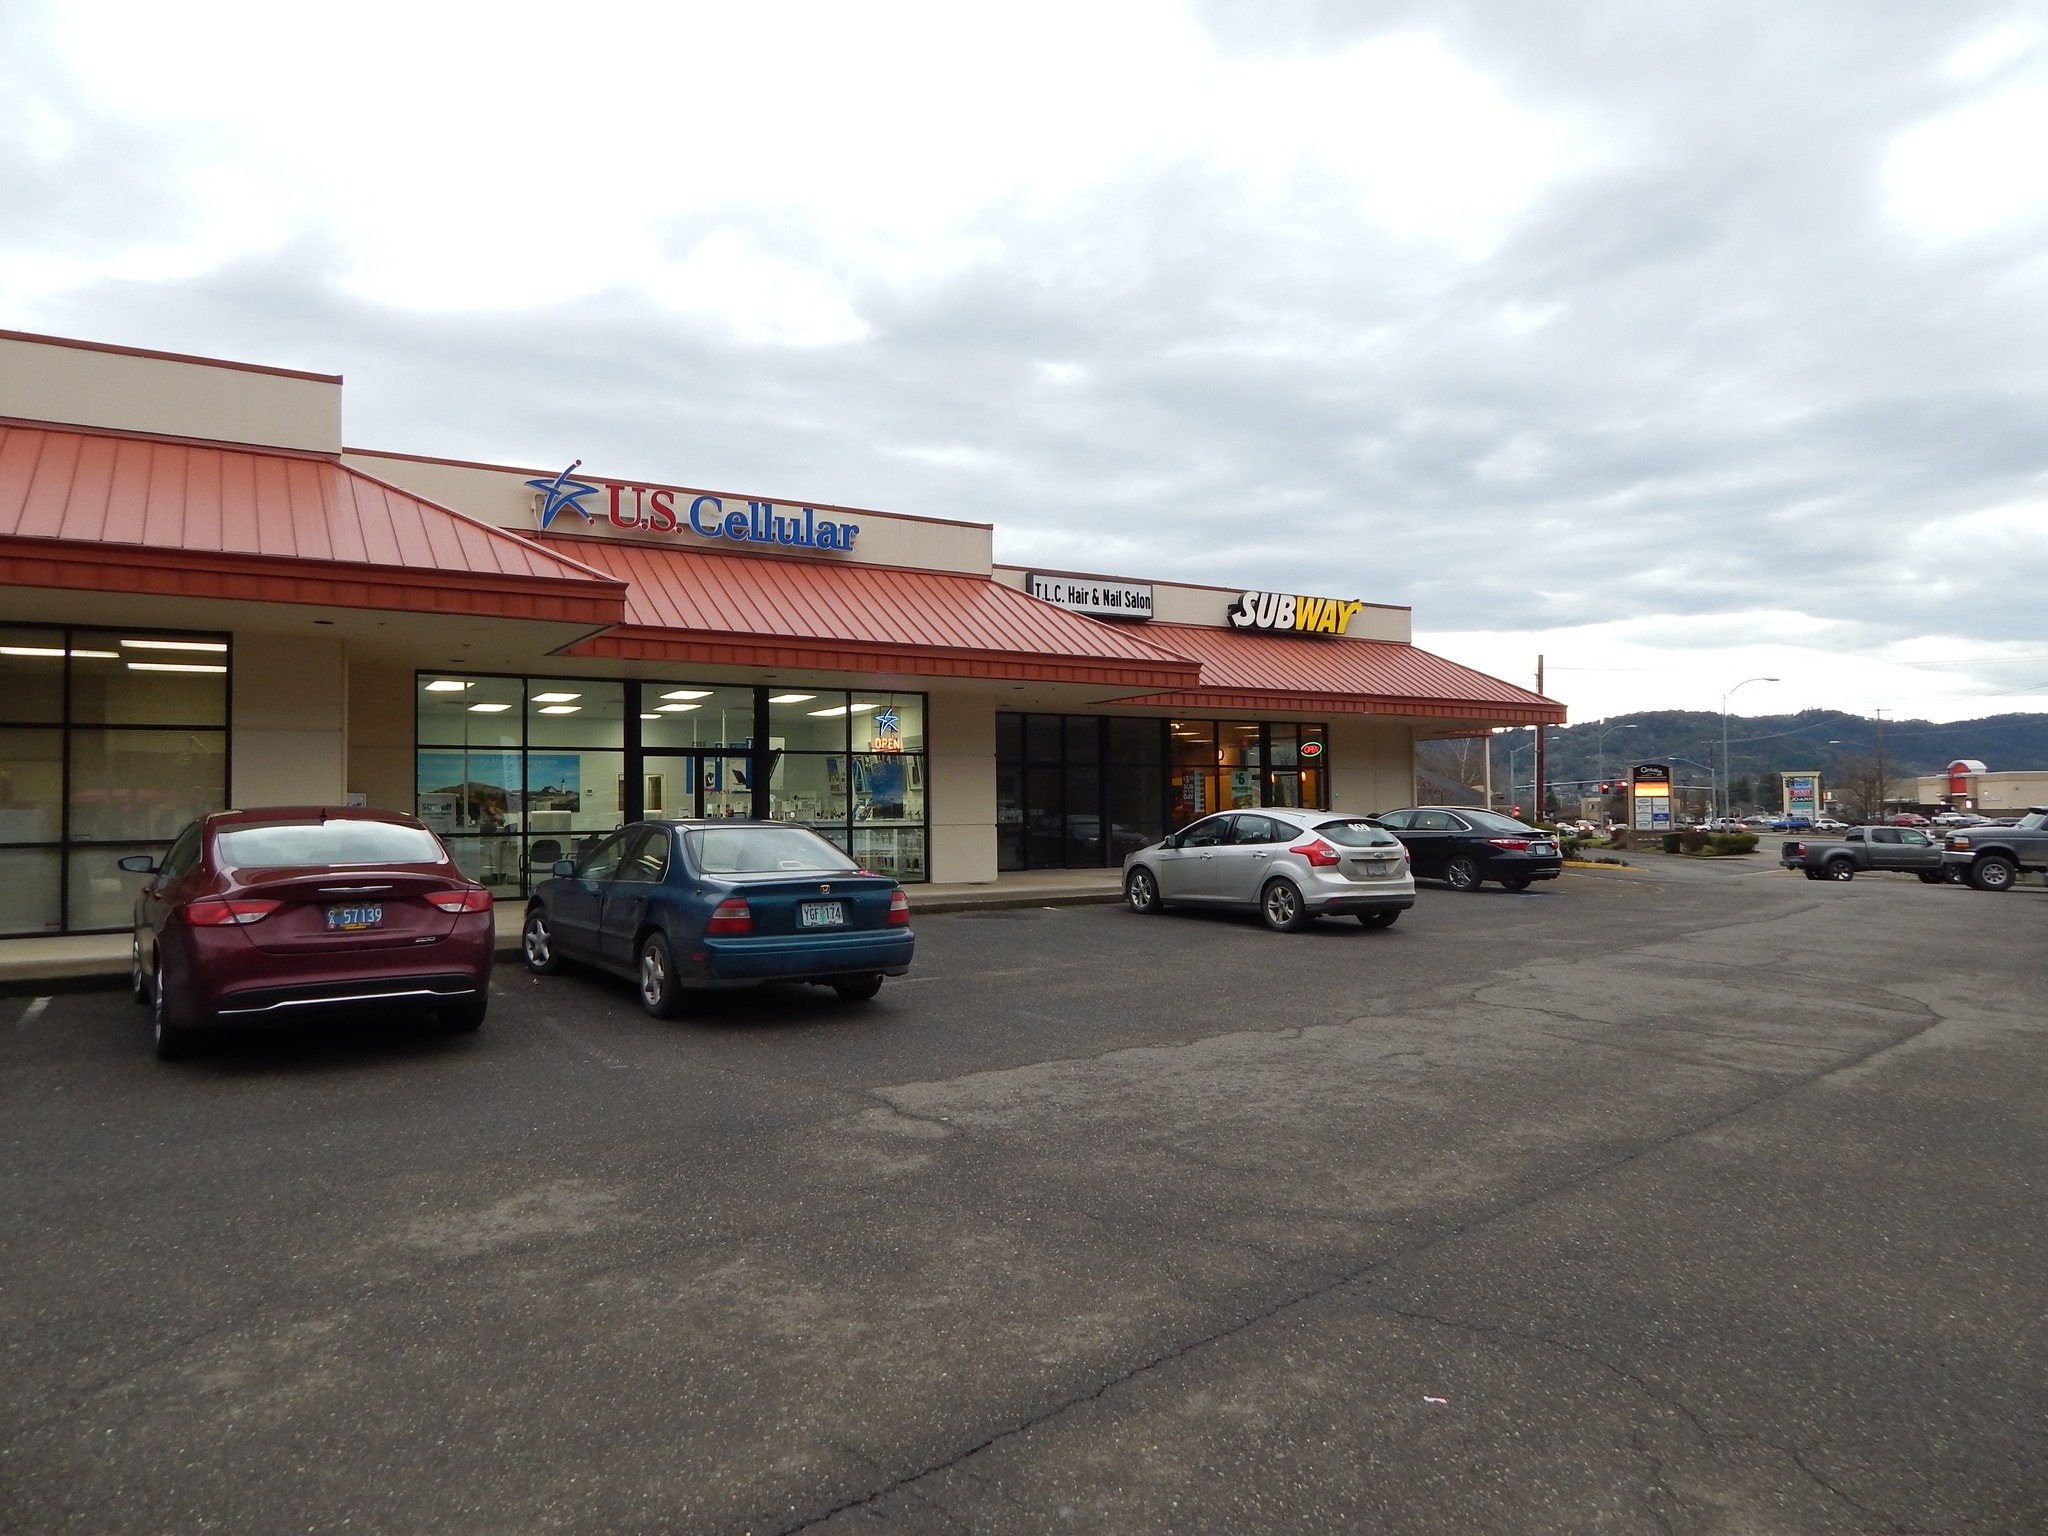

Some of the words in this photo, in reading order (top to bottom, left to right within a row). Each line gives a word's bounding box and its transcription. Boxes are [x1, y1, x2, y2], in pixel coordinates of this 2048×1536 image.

[605, 484, 683, 533] U.S.
[689, 495, 860, 551] Cellular
[1068, 586, 1089, 604] Hair
[1092, 588, 1099, 605] &
[1103, 589, 1121, 607] Nail
[1125, 591, 1151, 610] Salon
[1231, 591, 1364, 634] SUBWAY
[874, 737, 900, 749] OPEN
[1303, 745, 1319, 754] OPEN
[441, 803, 452, 811] off
[343, 908, 382, 924] 57139
[804, 908, 819, 920] YGF
[825, 906, 841, 919] 174
